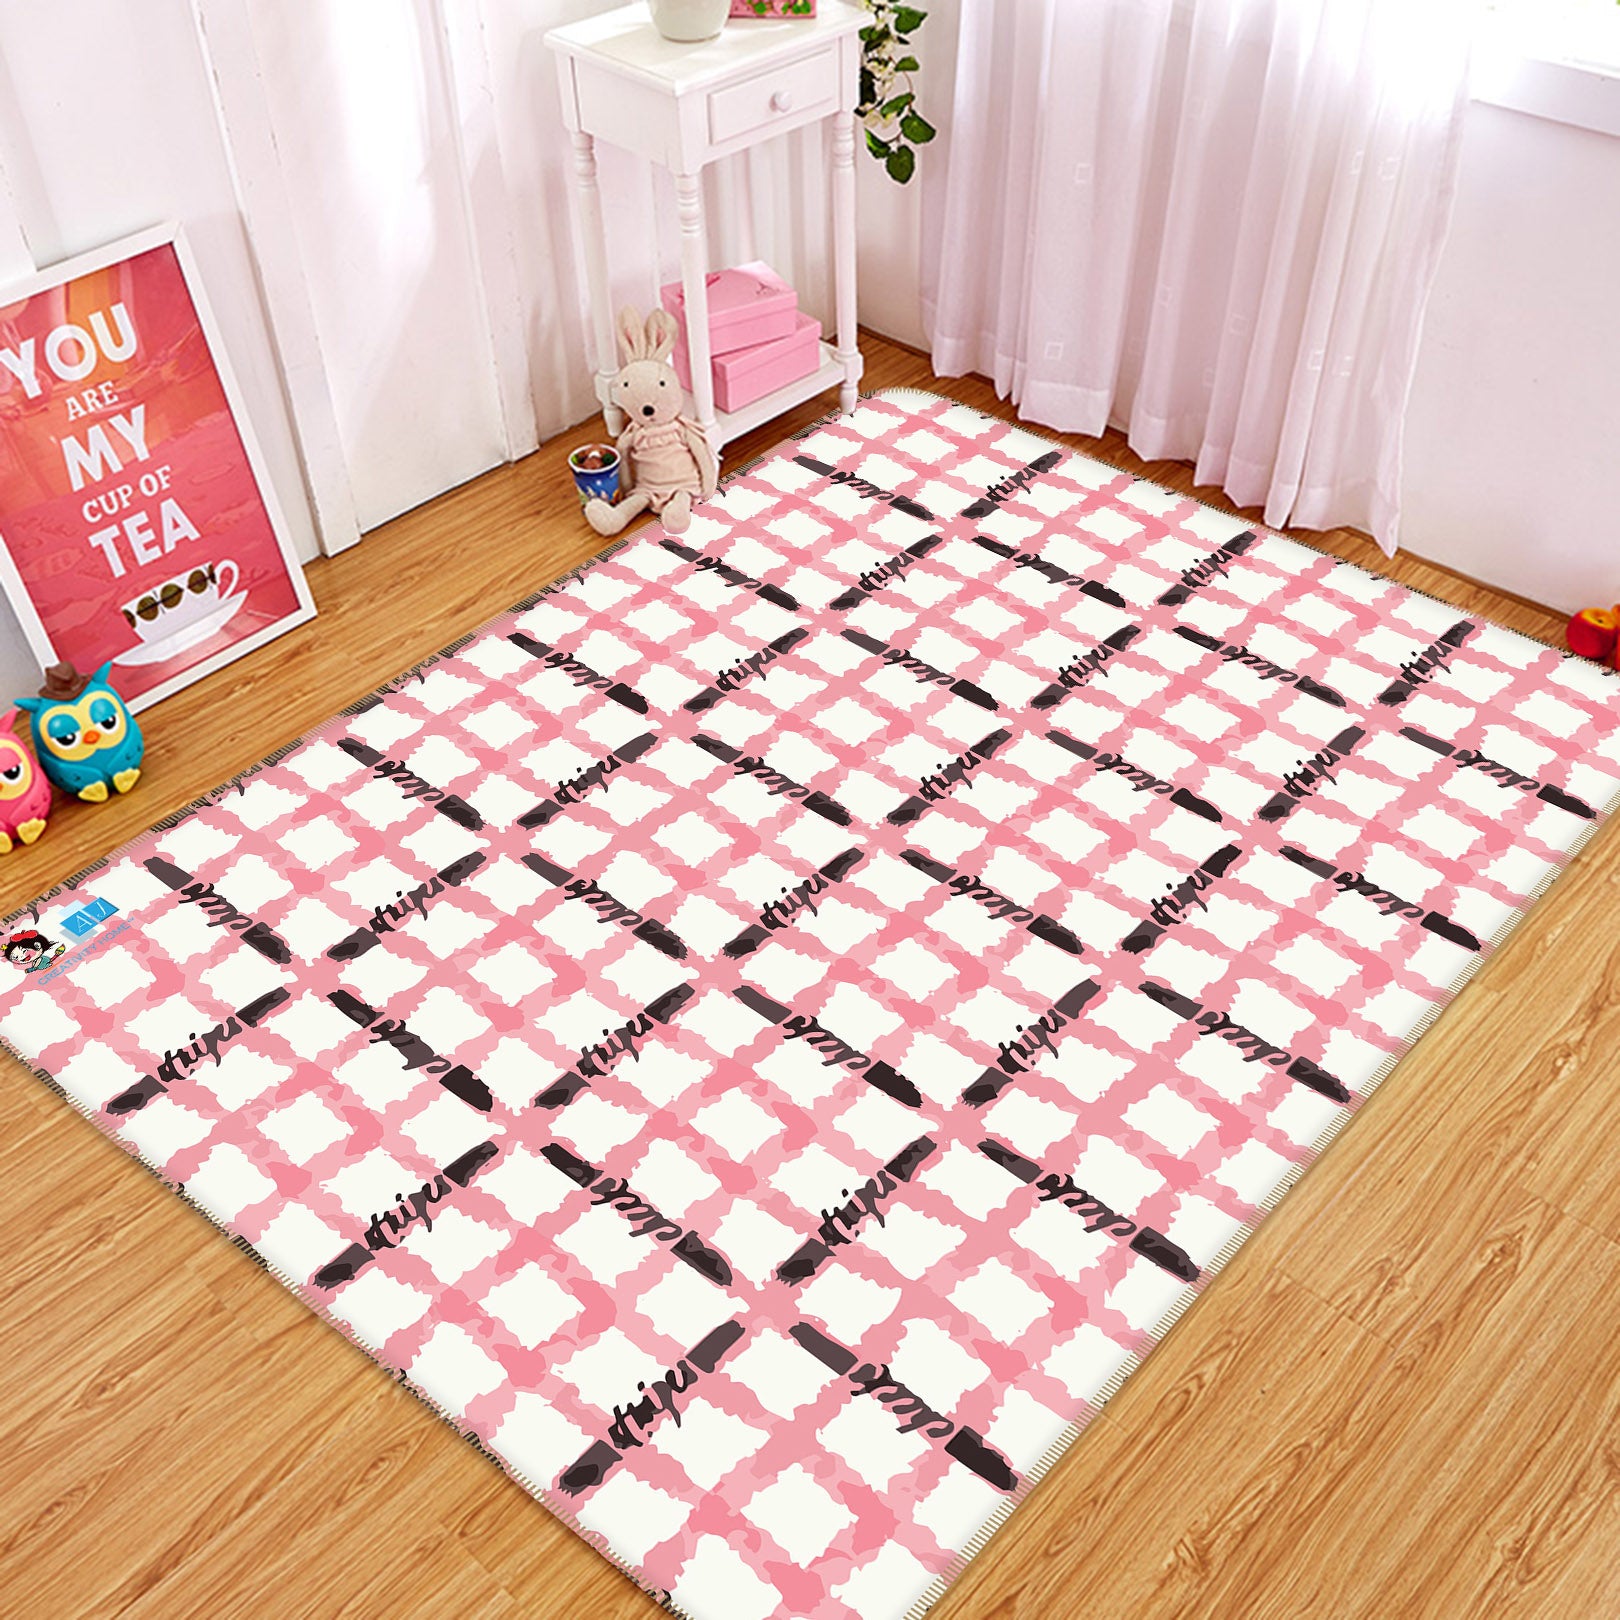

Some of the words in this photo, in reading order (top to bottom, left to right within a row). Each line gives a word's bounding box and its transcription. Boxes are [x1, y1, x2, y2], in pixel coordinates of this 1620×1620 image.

[0, 302, 139, 398] YOU
[65, 380, 119, 421] ARE
[60, 404, 151, 492] MY
[82, 482, 134, 523] CUP
[139, 465, 172, 498] OF
[89, 498, 201, 578] TEA
[38, 944, 97, 985] CREATIVITY
[98, 923, 131, 946] HOME
